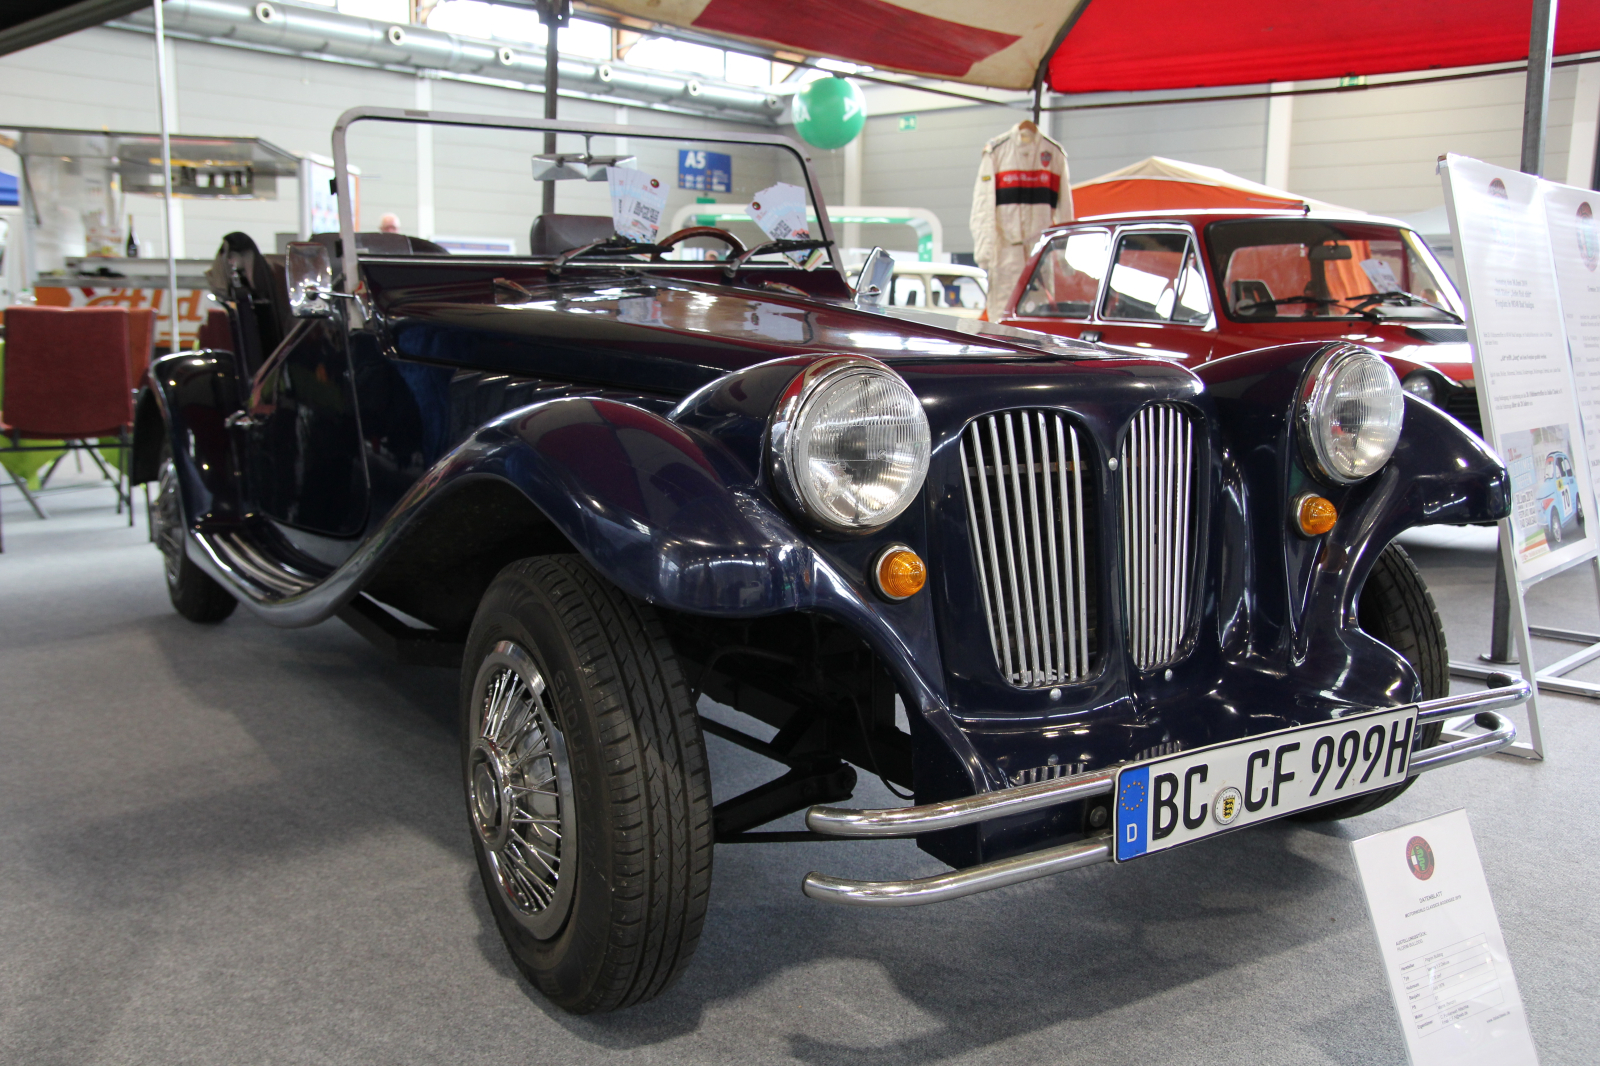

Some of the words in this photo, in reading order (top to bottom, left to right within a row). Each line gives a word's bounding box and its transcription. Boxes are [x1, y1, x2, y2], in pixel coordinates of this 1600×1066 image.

[684, 150, 706, 170] A5
[1152, 763, 1209, 841] BC
[1244, 741, 1300, 813] CF
[1309, 717, 1414, 797] 999H
[1126, 823, 1138, 843] D
